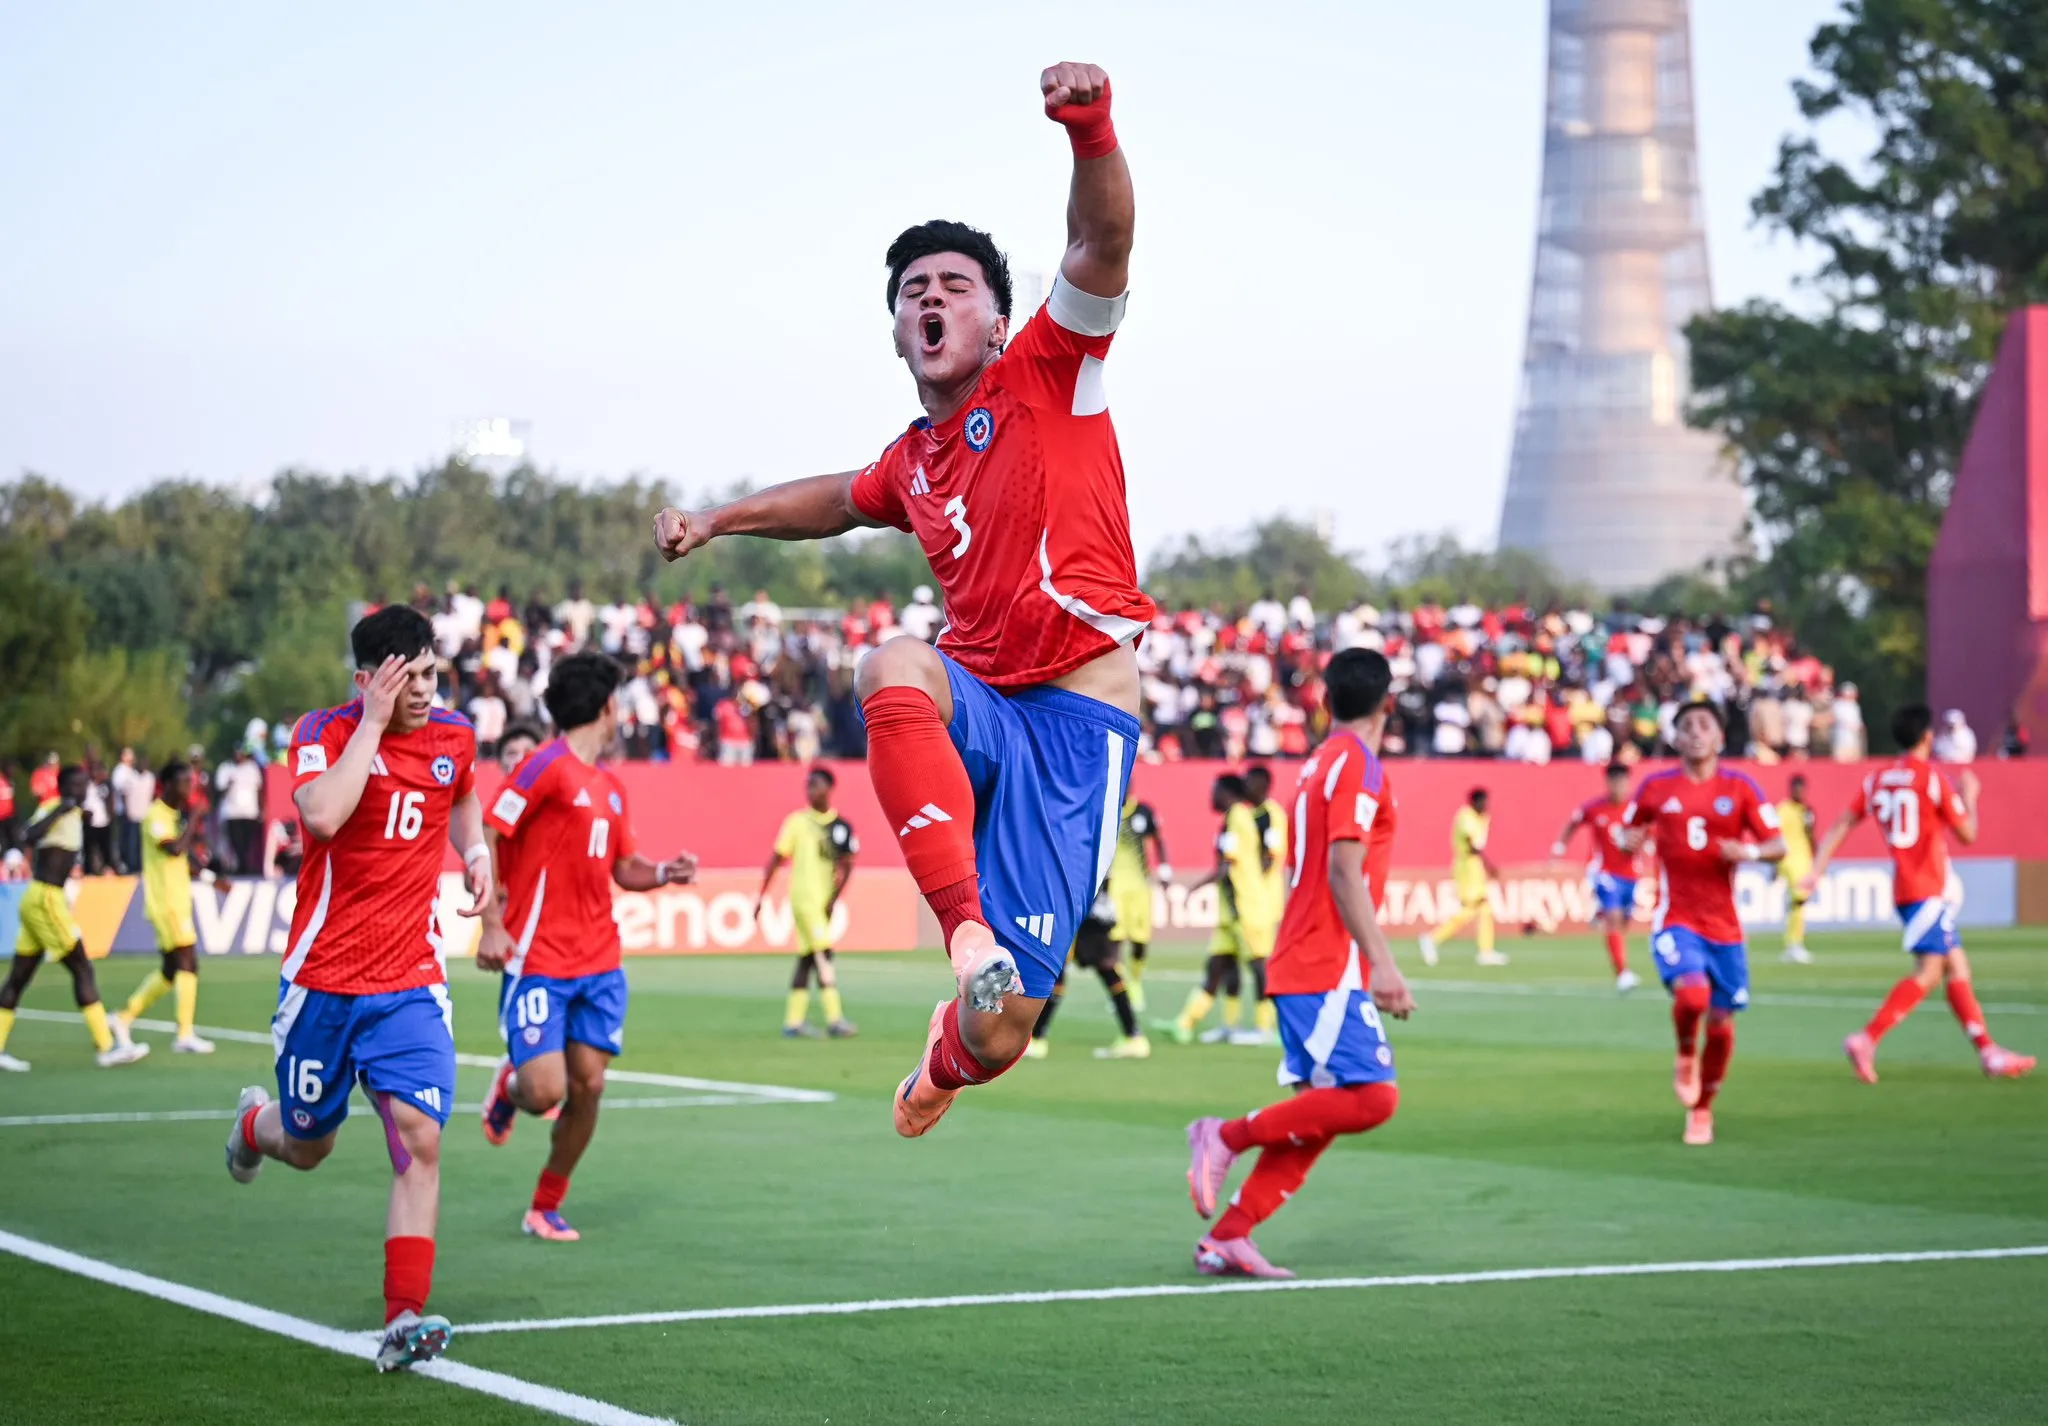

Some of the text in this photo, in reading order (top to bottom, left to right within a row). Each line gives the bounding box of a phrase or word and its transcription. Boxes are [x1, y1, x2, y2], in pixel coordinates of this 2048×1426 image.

[944, 494, 972, 560] 3
[384, 790, 425, 841] 16
[1687, 816, 1708, 851] 6
[191, 879, 298, 955] VIS
[517, 987, 549, 1028] 10
[1359, 1001, 1387, 1043] 9
[289, 1055, 324, 1103] 16
